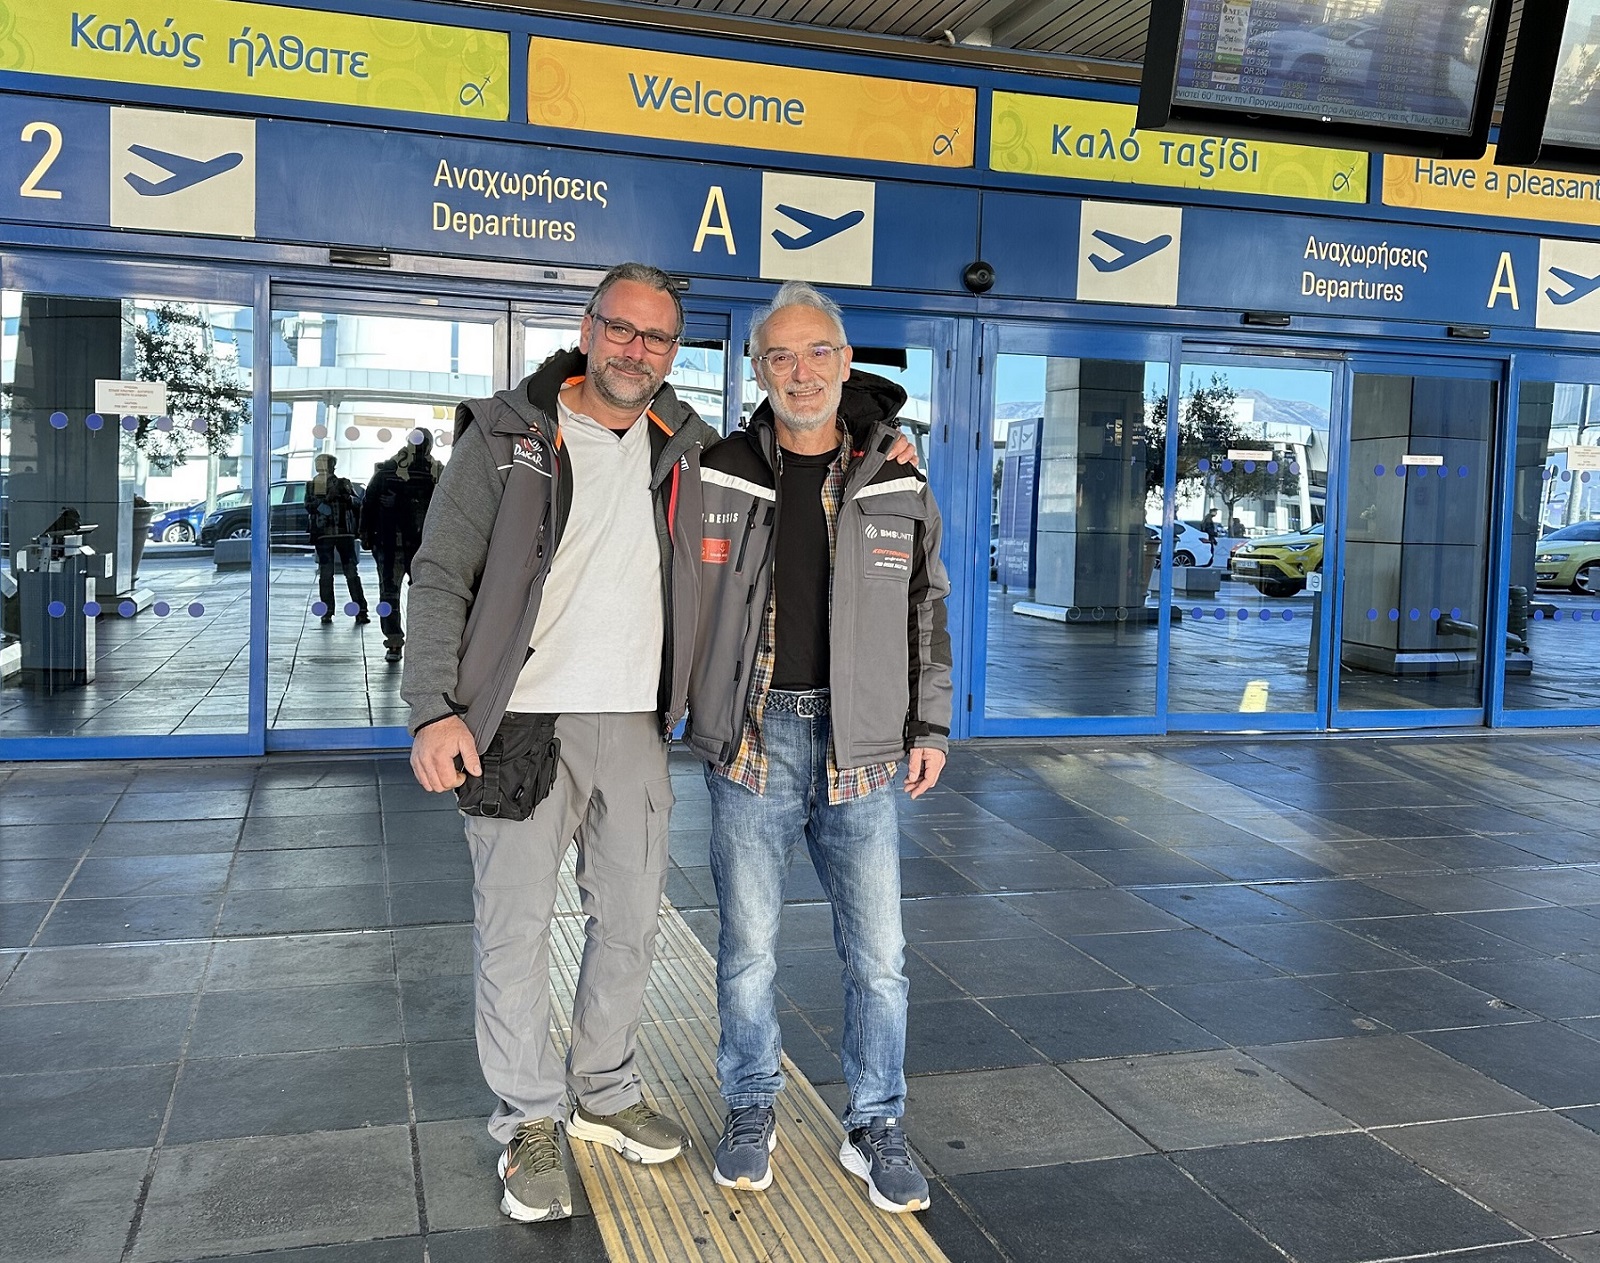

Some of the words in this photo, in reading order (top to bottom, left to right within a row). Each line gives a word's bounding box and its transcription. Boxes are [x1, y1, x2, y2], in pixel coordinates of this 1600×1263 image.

[70, 12, 205, 68] Καλώς
[227, 26, 370, 79] ήλθατε
[1243, 67, 1255, 75] QR
[1255, 68, 1268, 76] 204
[1252, 87, 1264, 95] 778
[628, 73, 805, 126] Welcome
[20, 121, 63, 200] 2
[1051, 124, 1140, 162] Καλό
[1158, 135, 1260, 179] ταξίδι
[433, 158, 609, 209] Αναχωρήσεις
[1414, 158, 1477, 189] Have
[1484, 170, 1500, 191] a
[1506, 168, 1600, 202] pleasant
[432, 202, 577, 243] Departures
[692, 185, 738, 256] A
[1303, 235, 1428, 274] Αναχωρήσεις
[1301, 270, 1405, 303] Departures
[1486, 251, 1520, 311] A
